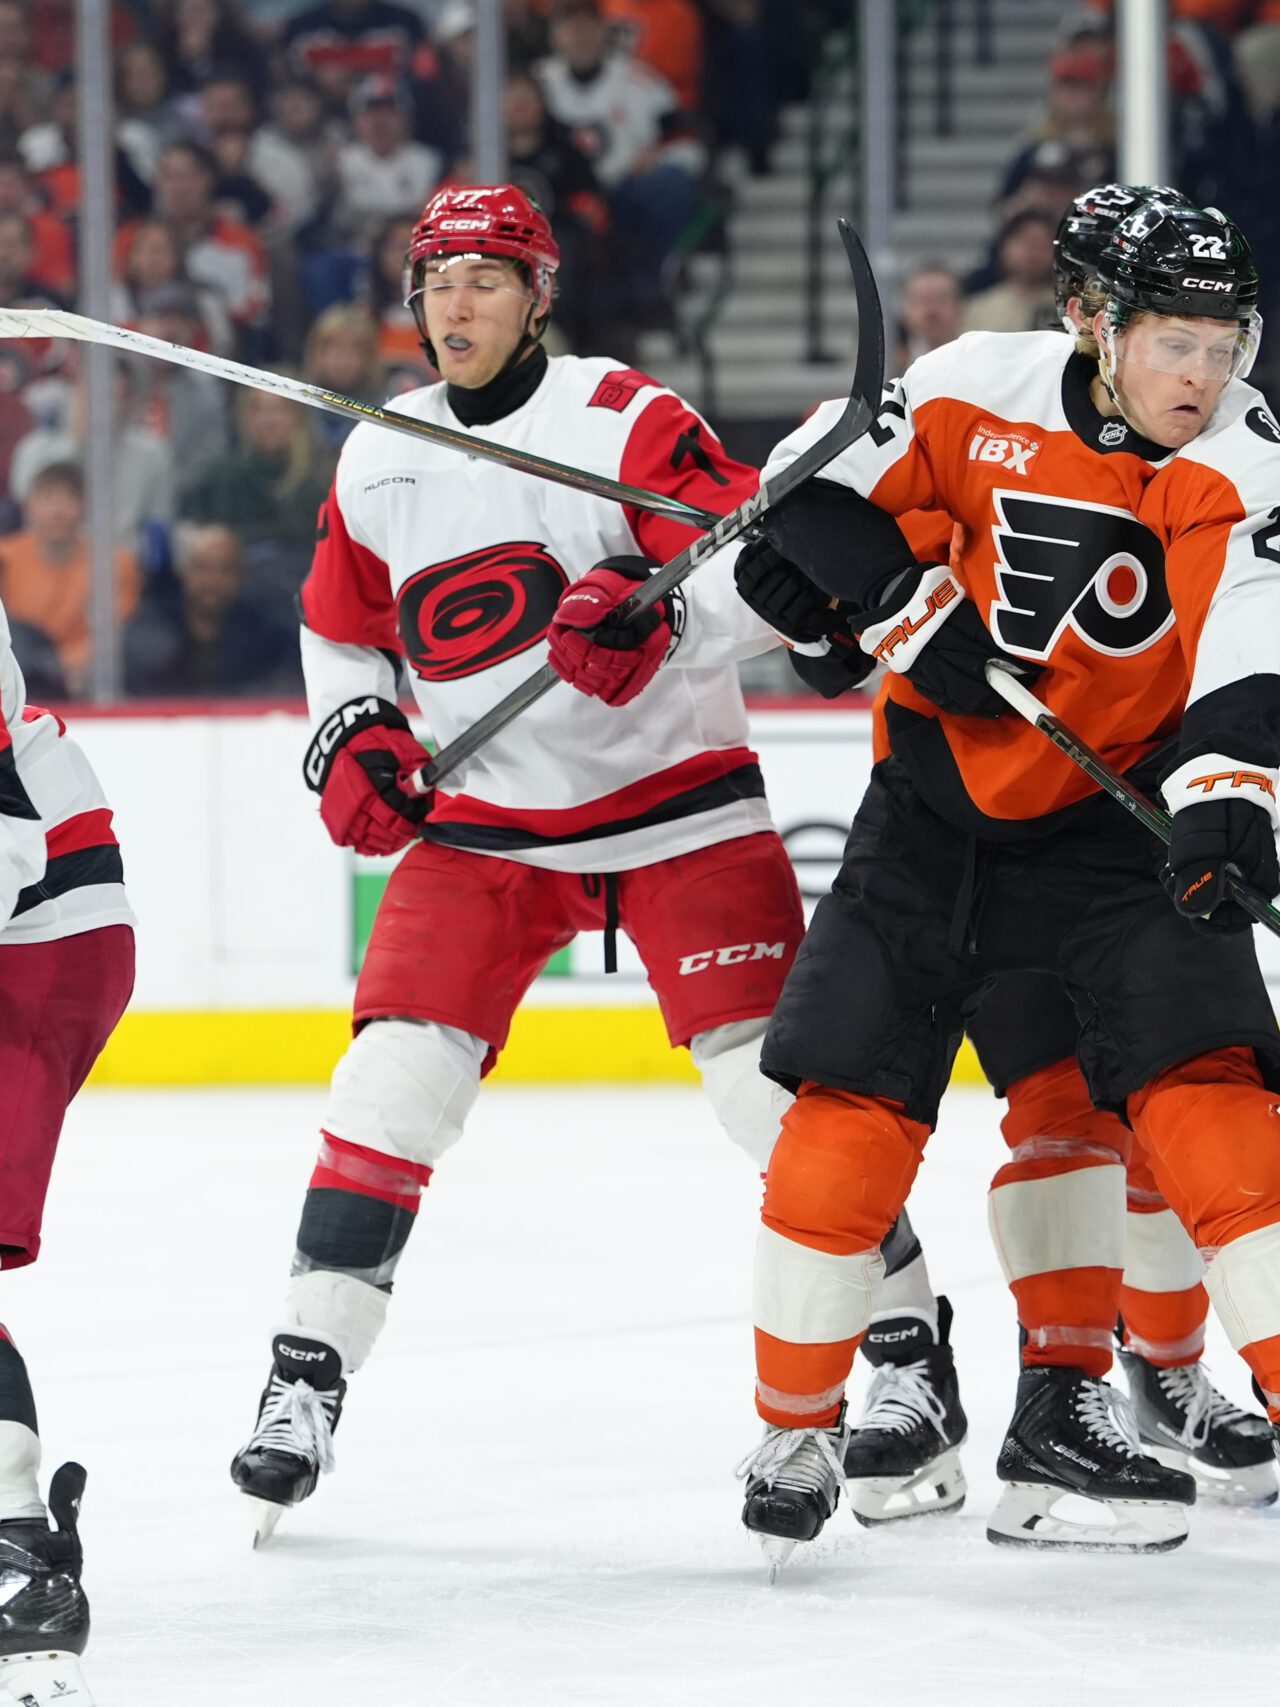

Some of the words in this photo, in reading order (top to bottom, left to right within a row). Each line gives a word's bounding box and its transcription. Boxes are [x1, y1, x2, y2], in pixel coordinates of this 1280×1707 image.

[440, 219, 490, 230] CCM
[1189, 234, 1227, 260] 22
[1182, 277, 1233, 292] CCM
[977, 424, 1031, 446] Independence
[968, 436, 1037, 476] IBX
[689, 485, 769, 566] CCM
[871, 577, 958, 663] TRUE
[306, 697, 380, 787] CCM
[1182, 871, 1213, 902] TRUE
[678, 942, 786, 976] CCM
[868, 1325, 919, 1343] CCM
[278, 1343, 327, 1361] CCM
[1057, 1444, 1100, 1472] BAUER
